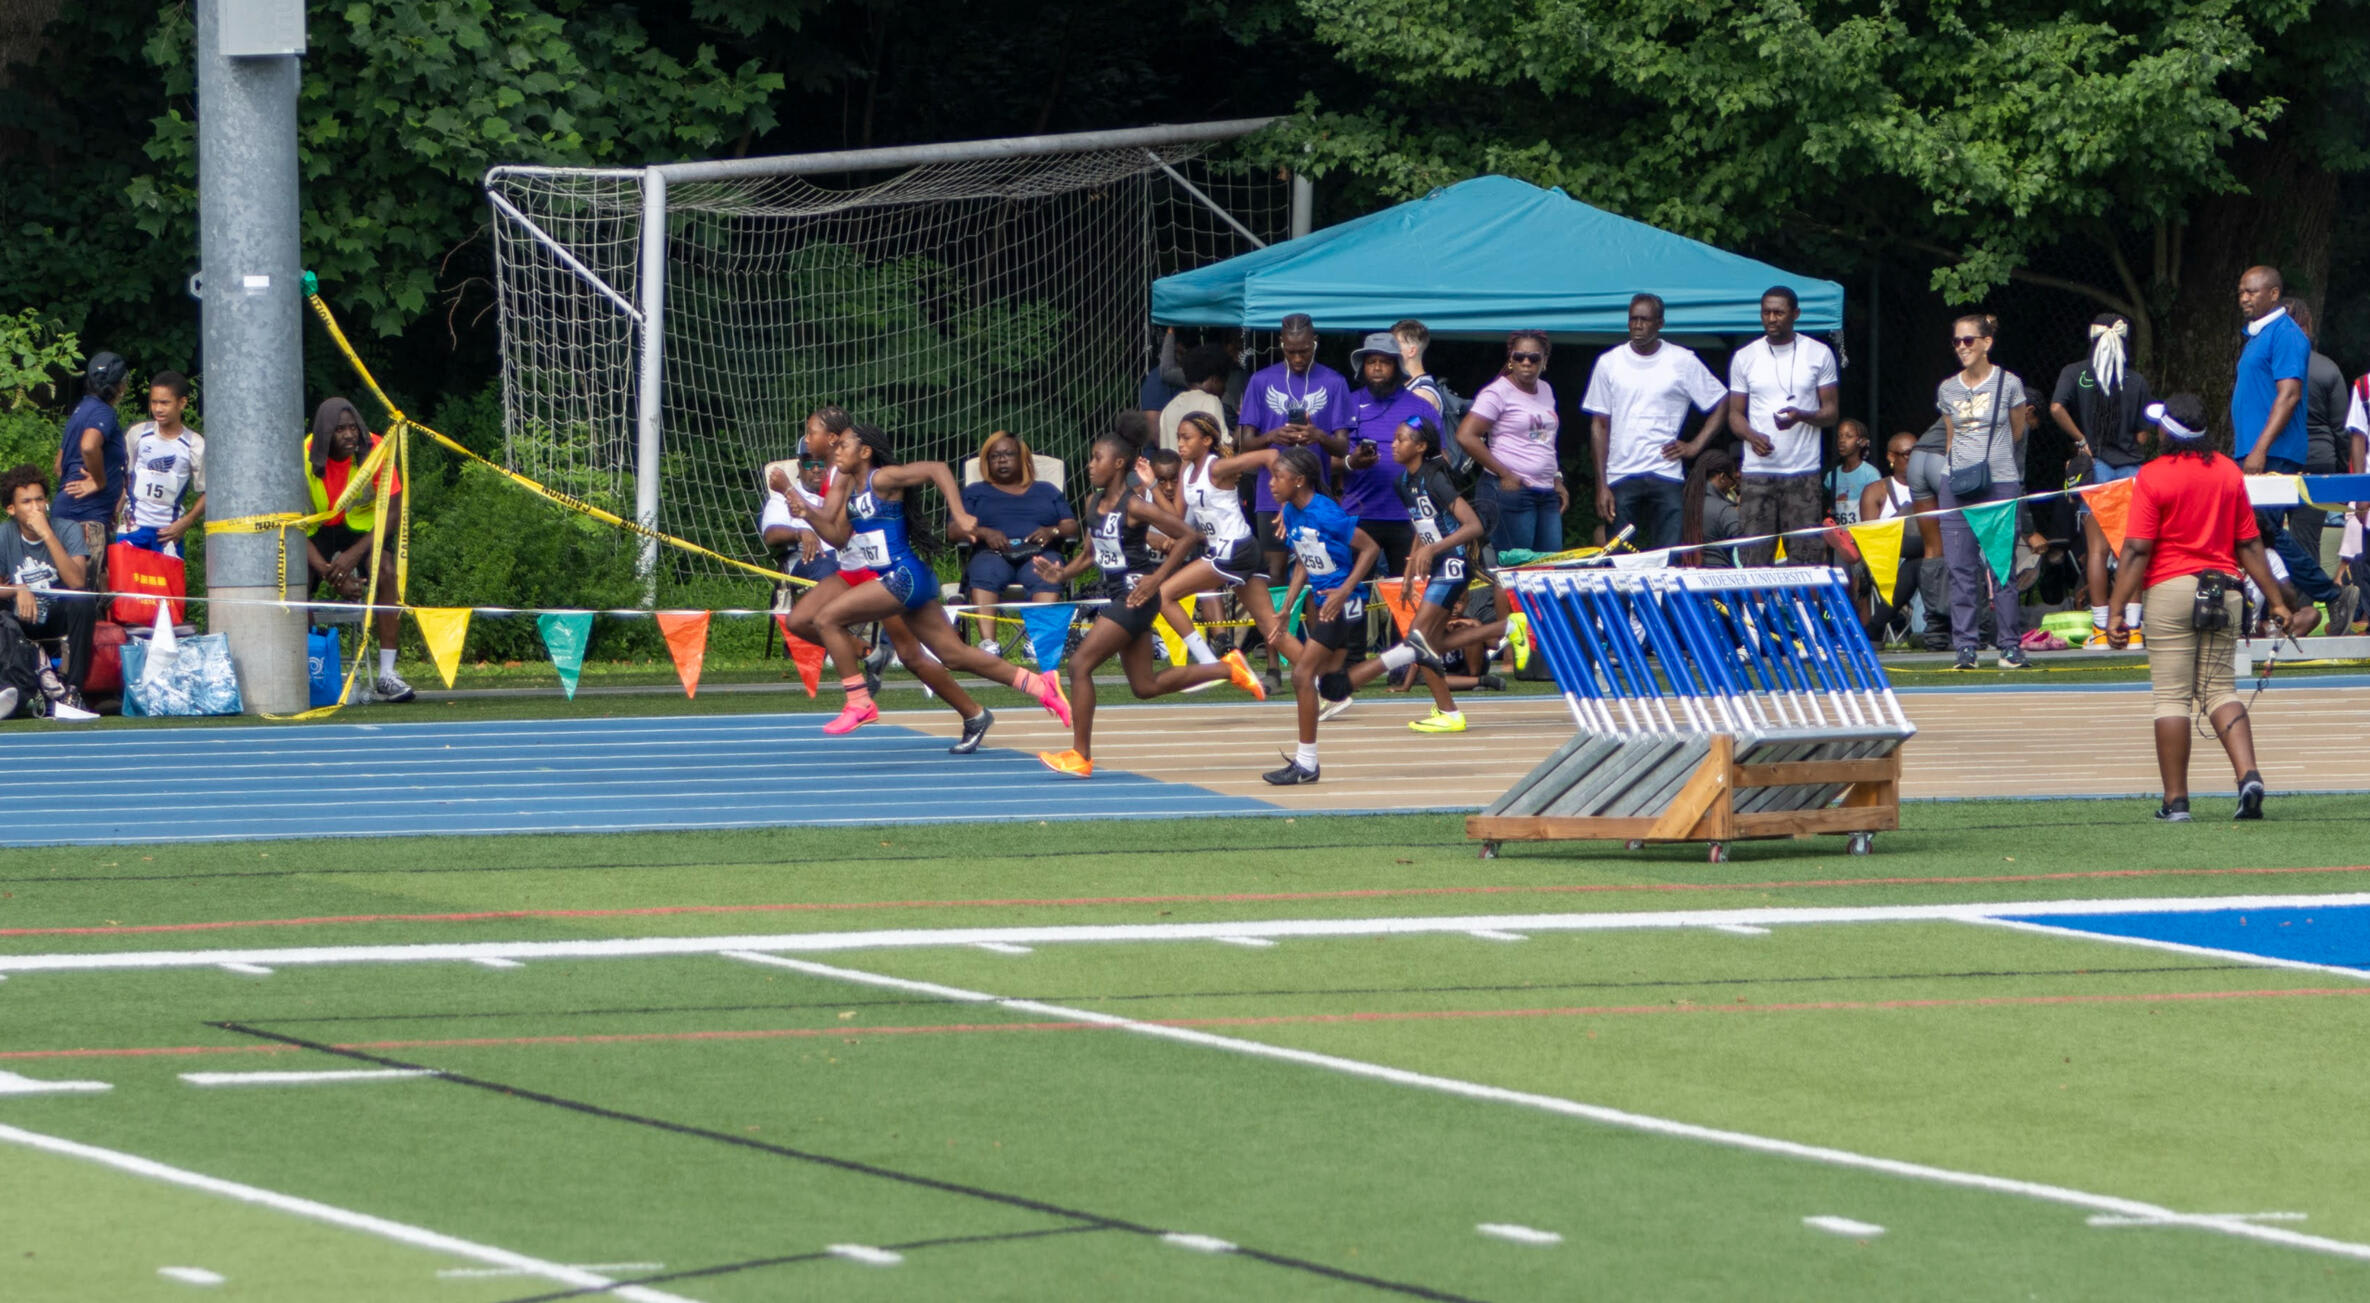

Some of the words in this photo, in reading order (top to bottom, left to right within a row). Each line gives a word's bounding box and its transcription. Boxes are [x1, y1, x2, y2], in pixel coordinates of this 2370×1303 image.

[146, 483, 163, 498] 15
[1196, 489, 1204, 507] 7
[861, 496, 871, 514] 4
[1420, 499, 1434, 517] 6
[1106, 515, 1117, 534] 3
[1218, 538, 1229, 557] 7
[1301, 553, 1325, 569] 259
[1448, 560, 1461, 577] 6
[1698, 574, 1748, 586] WIDENER
[1751, 571, 1814, 584] UNIVERSITY
[1348, 600, 1360, 616] 2
